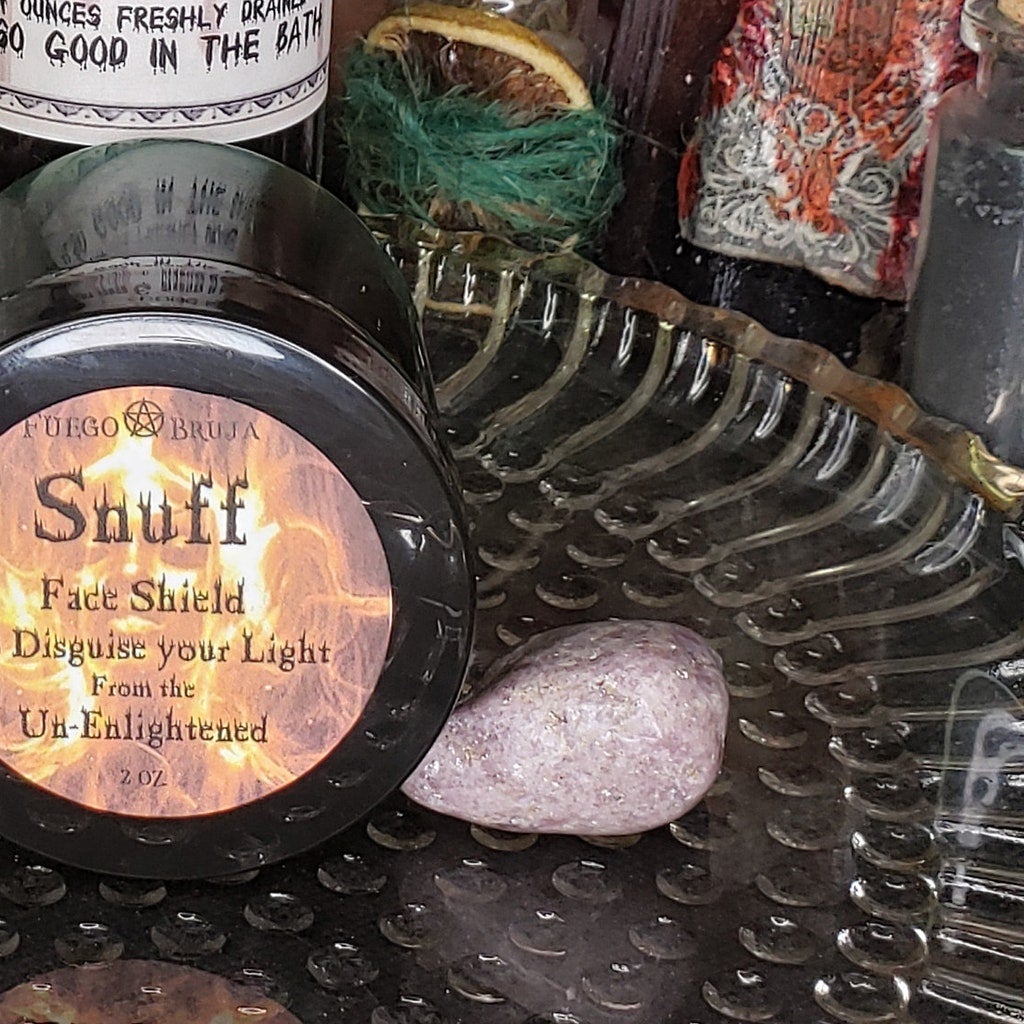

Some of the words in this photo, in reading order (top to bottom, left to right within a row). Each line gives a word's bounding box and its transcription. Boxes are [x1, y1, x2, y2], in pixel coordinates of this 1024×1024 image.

[45, 30, 128, 71] GOOD
[150, 37, 178, 74] IN
[201, 29, 261, 73] THE
[276, 4, 323, 59] BATH
[116, 3, 228, 34] FRESHLY
[23, 413, 119, 439] FUEGO
[171, 416, 260, 441] BRUJA
[33, 466, 249, 546] Snuff
[40, 572, 118, 613] Face
[130, 573, 246, 616] Shield
[11, 625, 146, 667] Disguise
[157, 636, 231, 671] your
[240, 623, 332, 672] Light
[91, 673, 153, 698] From
[160, 674, 196, 698] the
[18, 705, 270, 748] Un-Enlightened
[121, 769, 132, 785] 2
